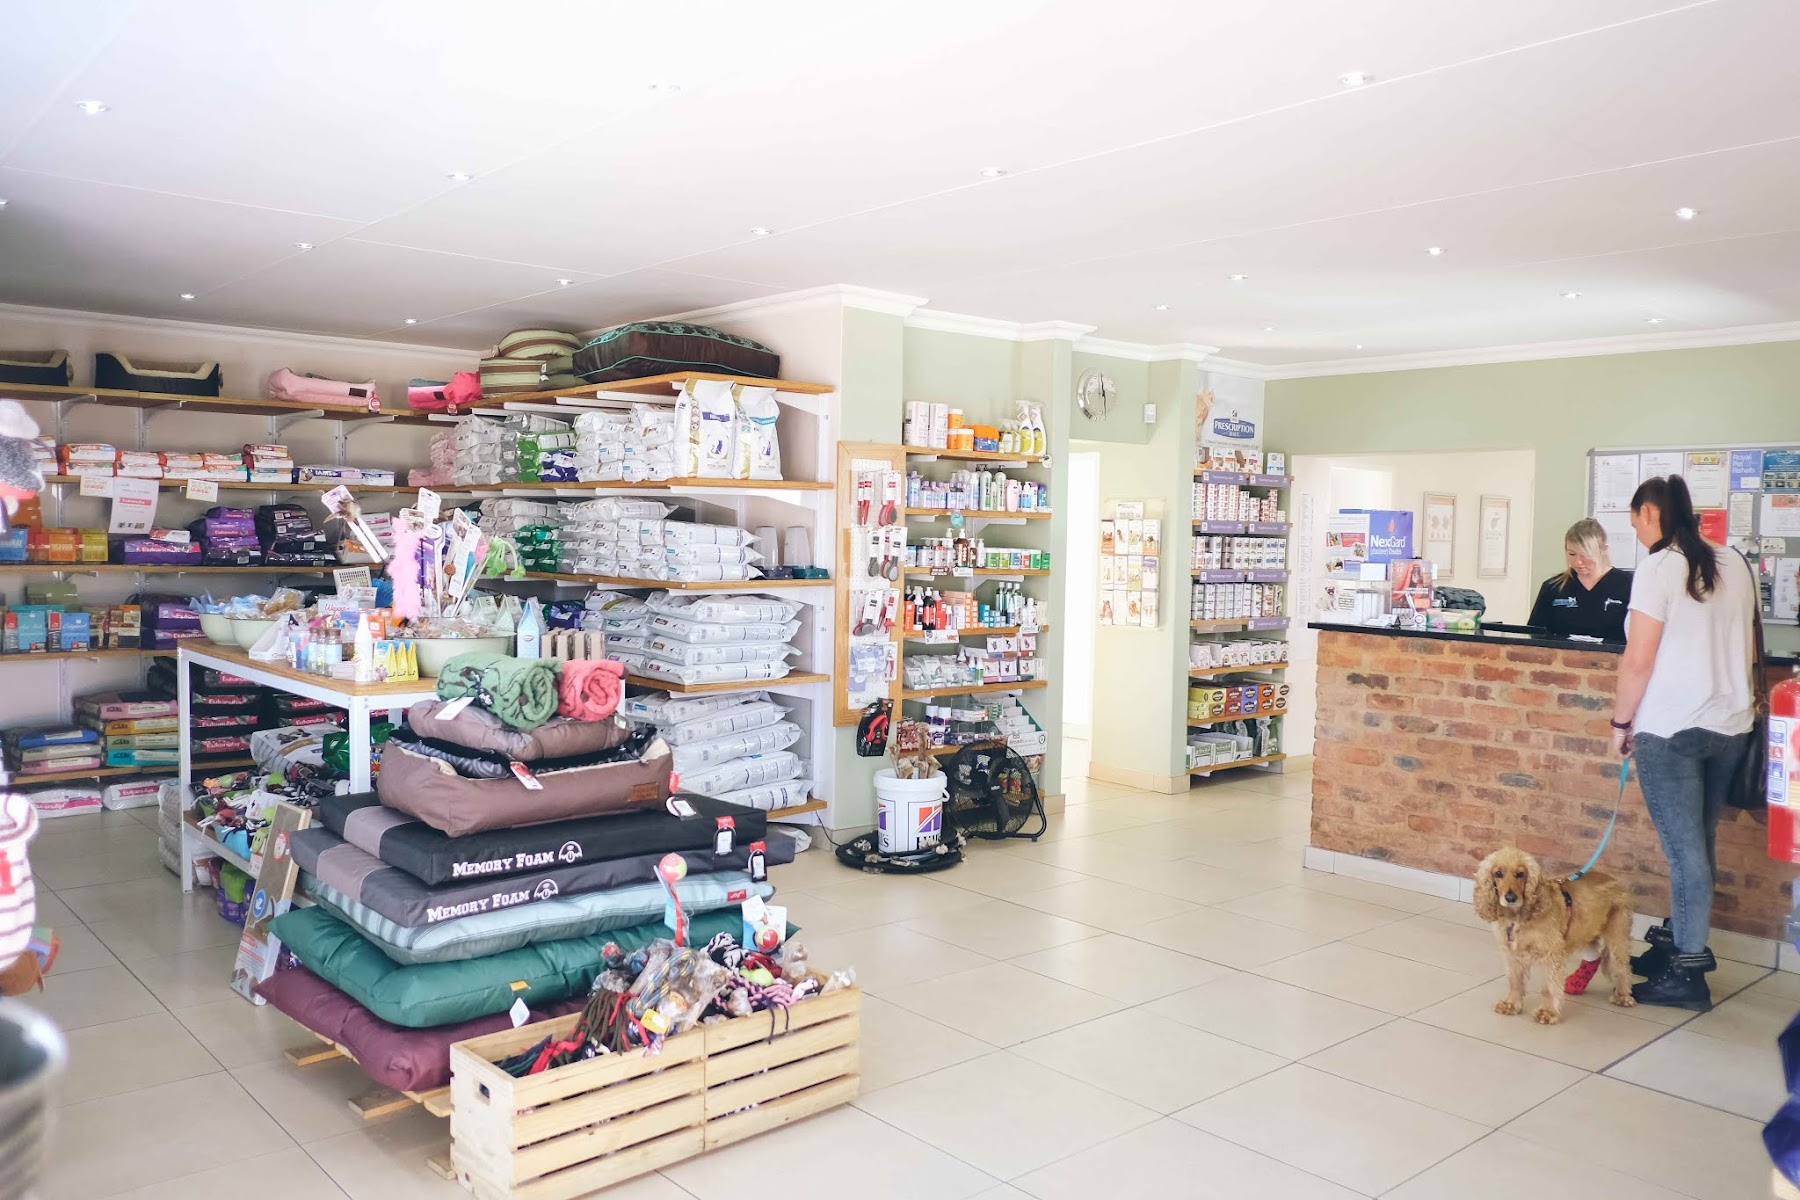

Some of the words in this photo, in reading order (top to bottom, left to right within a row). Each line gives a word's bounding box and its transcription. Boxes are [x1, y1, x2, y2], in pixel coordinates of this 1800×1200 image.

[1214, 420, 1254, 434] PRESCRIPTION
[1733, 454, 1752, 462] Royal
[1370, 534, 1406, 548] NexGard
[295, 717, 325, 725] Eukanuba
[452, 857, 513, 877] MEMORY
[516, 851, 555, 868] FOAM
[427, 898, 489, 923] MEMORY
[492, 890, 531, 907] FOAM
